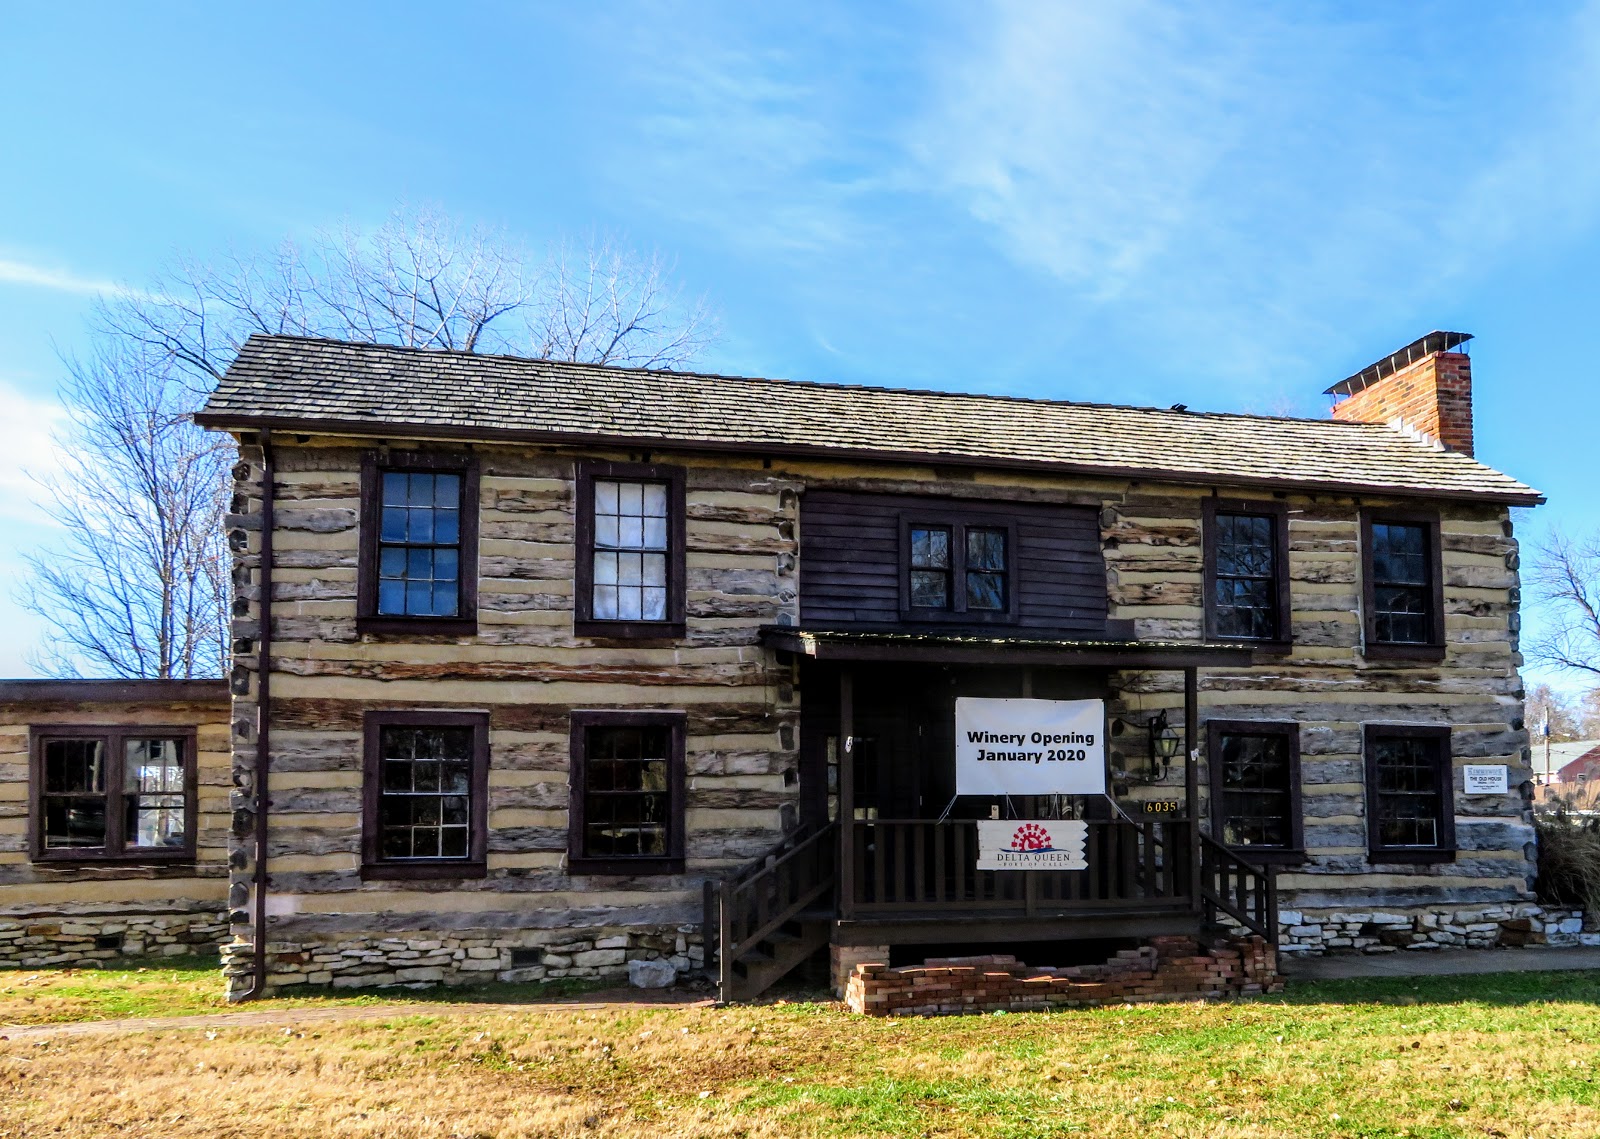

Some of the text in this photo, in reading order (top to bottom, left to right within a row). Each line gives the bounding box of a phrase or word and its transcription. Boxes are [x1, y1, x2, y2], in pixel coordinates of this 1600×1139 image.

[967, 731, 1095, 747] Winery Opening
[976, 749, 1086, 764] January 2020
[1147, 802, 1176, 812] 6035
[997, 853, 1070, 863] DELTA QUEEN
